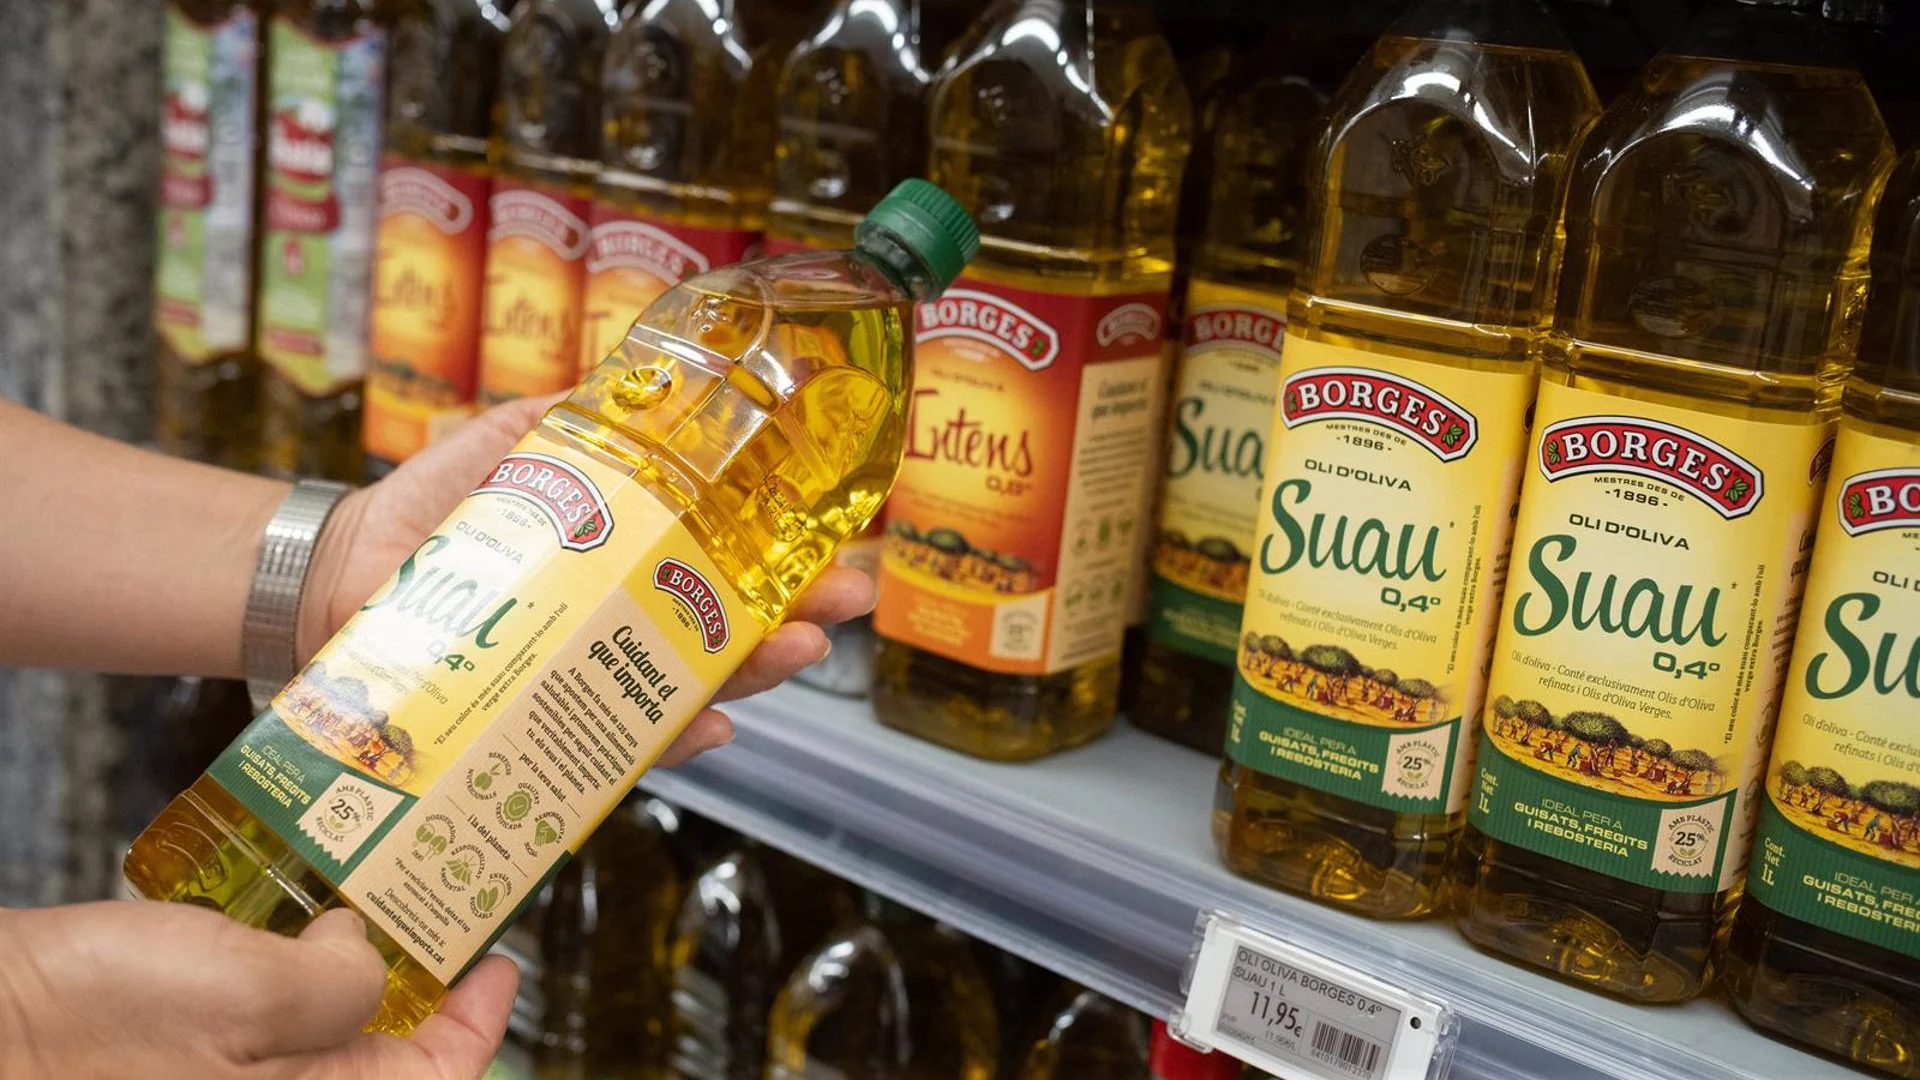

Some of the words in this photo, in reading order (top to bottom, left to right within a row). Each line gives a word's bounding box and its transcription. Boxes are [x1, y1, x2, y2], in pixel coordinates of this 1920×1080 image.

[921, 302, 1033, 349] BORGES
[1195, 313, 1284, 350] BORG
[1298, 380, 1447, 436] BORGES
[1166, 396, 1264, 479] Sua
[1304, 459, 1332, 474] OLI
[1336, 467, 1412, 491] D'OLIVA
[1562, 430, 1732, 493] BORGES
[490, 461, 592, 524] BORGES
[1594, 476, 1644, 488] MESTRES
[1647, 483, 1668, 494] DES
[1670, 490, 1685, 501] DE
[456, 520, 478, 541] OLI
[476, 532, 524, 564] D'OLIVA
[1260, 478, 1447, 581] Suau
[1568, 513, 1600, 531] OLI
[1605, 521, 1690, 550] D'OLIVA
[360, 535, 517, 648] Suau
[670, 569, 722, 635] BORGES
[1513, 534, 1728, 648] Suau
[1873, 571, 1908, 589] OLI
[455, 706, 472, 725] color
[542, 615, 557, 631] amb
[588, 639, 620, 671] que
[613, 662, 665, 725] importa
[612, 625, 667, 688] Cuidant
[658, 686, 678, 702] el
[1511, 650, 1521, 662] Oli
[1522, 653, 1551, 672] d'oliva
[1557, 664, 1586, 682] Conté
[1587, 672, 1656, 699] exclusivament
[1657, 688, 1678, 706] Olis
[1679, 694, 1716, 713] d'Oliva
[482, 692, 500, 711] verge
[499, 675, 516, 694] extra
[540, 680, 571, 713] saludable
[569, 713, 602, 748] promovem
[550, 669, 564, 684] que
[562, 682, 588, 712] apostem
[584, 708, 598, 721] per
[595, 719, 608, 734] una
[568, 667, 577, 676] A
[574, 671, 596, 698] Borges
[593, 693, 601, 705] fa
[599, 702, 612, 718] més
[610, 714, 620, 725] de
[624, 732, 638, 748] anys
[1538, 676, 1576, 696] refinats
[1581, 686, 1602, 702] Olis
[1602, 691, 1638, 711] d'Oliva
[1639, 702, 1673, 720] Verges.
[528, 710, 542, 725] que
[540, 722, 580, 767] veritablement
[532, 692, 567, 730] sostenibles
[562, 727, 576, 740] per
[574, 738, 592, 759] seguir
[590, 756, 611, 781] cuidant
[608, 777, 617, 787] el
[1283, 727, 1317, 745] IDEAL
[1319, 735, 1343, 751] PER
[1345, 744, 1356, 754] A
[1803, 714, 1814, 729] Oli
[1815, 717, 1848, 737] d'oliva
[1856, 731, 1887, 749] Conté
[240, 744, 276, 779] GUISATS,
[274, 772, 311, 805] FREGITS
[519, 753, 534, 767] per
[530, 763, 540, 774] la
[537, 770, 552, 787] teva
[549, 784, 567, 803] salut
[534, 737, 546, 750] els
[543, 746, 558, 764] teus
[558, 763, 568, 773] el
[1276, 749, 1362, 781] REBOSTERIA
[1321, 747, 1379, 774] FREGITS
[1480, 768, 1499, 787] Cont.
[1833, 741, 1875, 762] refinats
[1883, 753, 1906, 769] Olis
[241, 762, 293, 808] REBOSTERIA
[518, 782, 540, 804] QUALITAT
[1514, 802, 1582, 832] GUISATS,
[1584, 826, 1648, 850] FREGITS
[1541, 798, 1579, 818] IDEAL
[1582, 809, 1611, 826] PER
[1612, 820, 1623, 831] A
[1668, 816, 1685, 831] AMB
[471, 817, 480, 828] la
[477, 825, 491, 839] del
[486, 834, 511, 860] planeta
[1533, 821, 1629, 858] REBOSTERIA
[1803, 875, 1879, 909] GUISATS,
[1834, 871, 1877, 893] IDEAL
[1881, 886, 1913, 904] PER
[366, 891, 446, 965] cuidantelqueimporta.cat
[384, 888, 428, 932] Descobreix-ne
[426, 928, 441, 942] més
[1233, 965, 1267, 989] SUAU
[1270, 978, 1276, 993] 1
[1279, 984, 1286, 998] L
[1238, 950, 1259, 969] OLI
[1261, 957, 1298, 984] OLIVA
[1300, 972, 1355, 1007] BORGES
